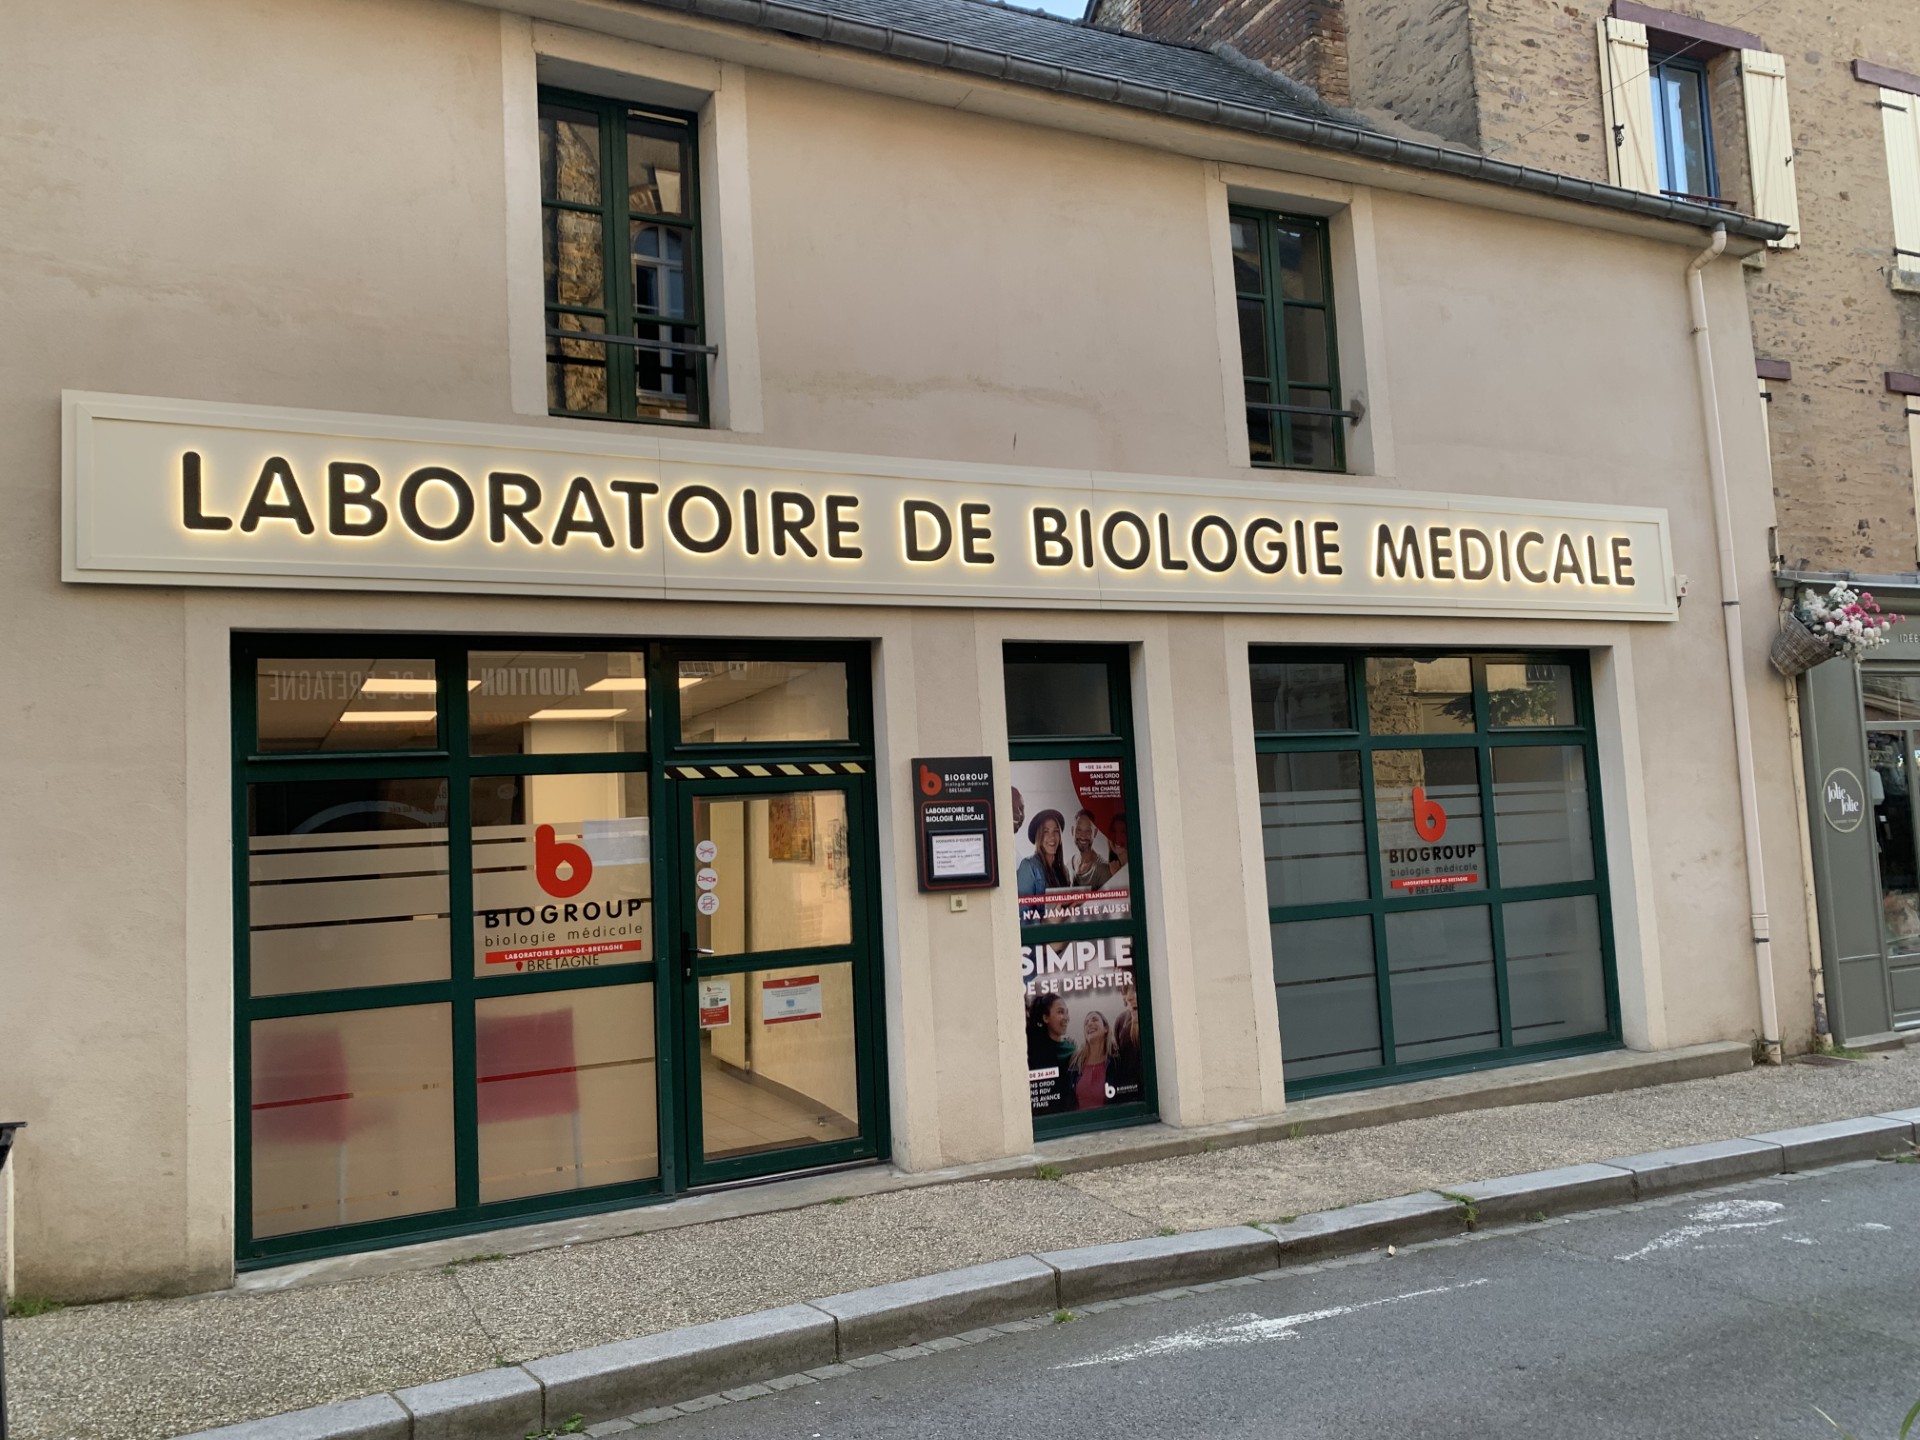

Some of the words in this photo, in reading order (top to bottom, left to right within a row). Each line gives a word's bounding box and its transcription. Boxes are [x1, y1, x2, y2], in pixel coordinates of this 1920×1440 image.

[182, 451, 863, 559] LABORATOIRE
[902, 499, 995, 564] DE
[1032, 506, 1343, 575] BIOLOGIE
[1375, 524, 1636, 586] MEDICALE
[944, 773, 989, 782] BIOGROUP
[925, 806, 965, 814] LABORATOIRE
[925, 814, 953, 822] BIOLOGIE
[955, 813, 985, 821] MÉDICALE
[1389, 844, 1476, 863] BIOGROUP
[1391, 867, 1431, 878] biologie
[1435, 862, 1478, 874] médicale
[1018, 896, 1045, 904] FECTIONS
[1045, 893, 1084, 902] SEXUELLEMENT
[1085, 890, 1128, 899] TRANSMISSIBLES
[484, 898, 642, 928] BIOGROUP
[1043, 906, 1080, 919] JAMAIS
[1083, 902, 1099, 915] ÉTÉ
[1102, 903, 1129, 914] AUSSI
[484, 931, 556, 947] biologie
[567, 923, 643, 941] médicale
[504, 950, 553, 960] LABORATOIRE
[555, 944, 623, 955] BAIN-DE-BRETAGNE
[1020, 937, 1133, 977] SIMPLE
[527, 954, 600, 971] BRETAGNE
[1041, 978, 1059, 994] SE
[1063, 971, 1134, 992] DÉPISTER
[1039, 1079, 1056, 1087] ORDO
[1040, 1092, 1061, 1102] AVANCE
